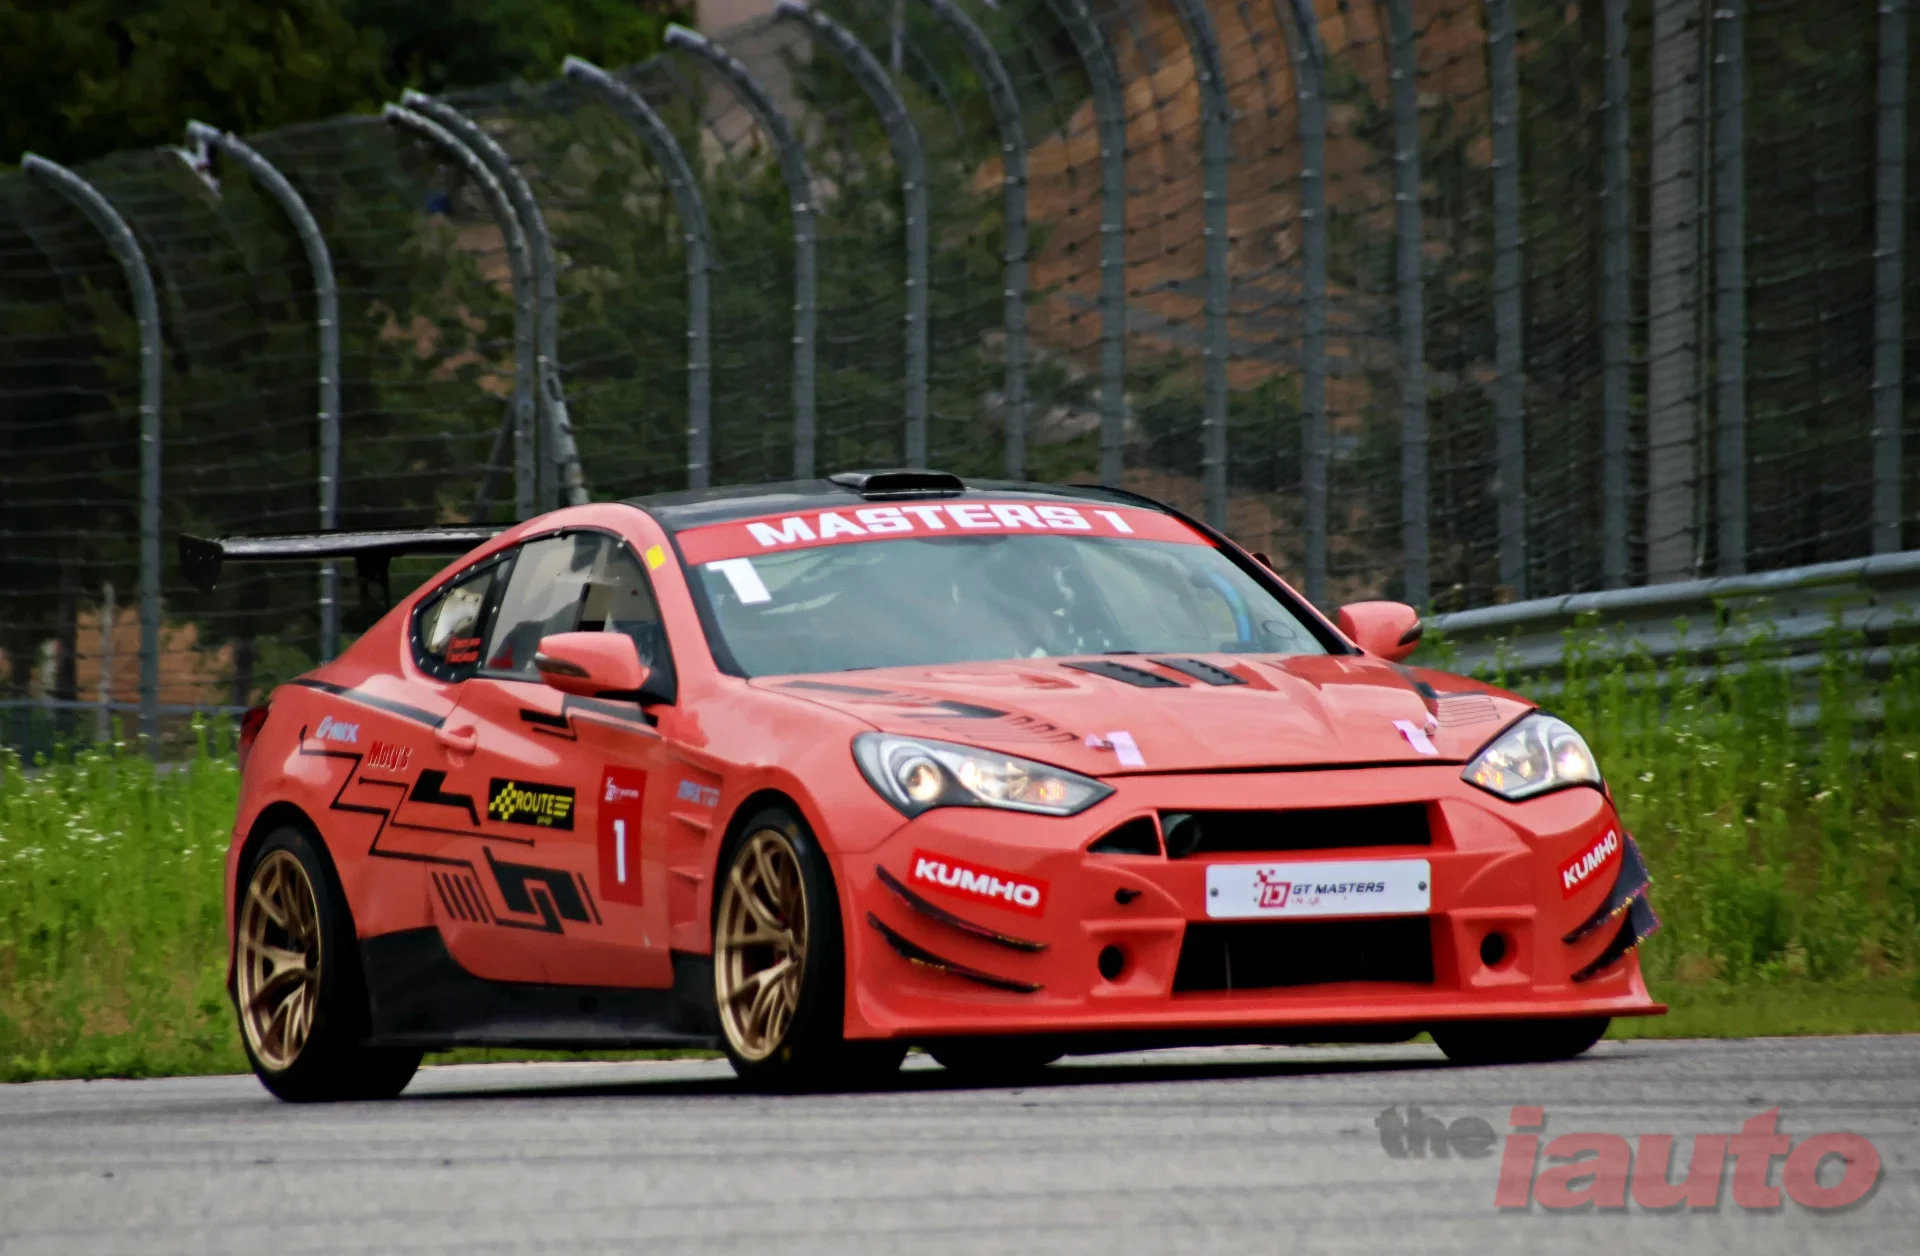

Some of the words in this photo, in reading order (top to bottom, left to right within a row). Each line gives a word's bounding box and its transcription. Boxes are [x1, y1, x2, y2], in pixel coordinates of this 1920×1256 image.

[746, 504, 1092, 547] MASTERS
[1097, 511, 1133, 533] 1
[706, 557, 772, 604] 1
[515, 791, 555, 815] ROUTE
[613, 819, 626, 884] 1
[1563, 829, 1618, 889] KUMHO
[915, 858, 1040, 907] KUMHO
[1292, 884, 1312, 895] GT
[1315, 882, 1385, 894] MASTERS
